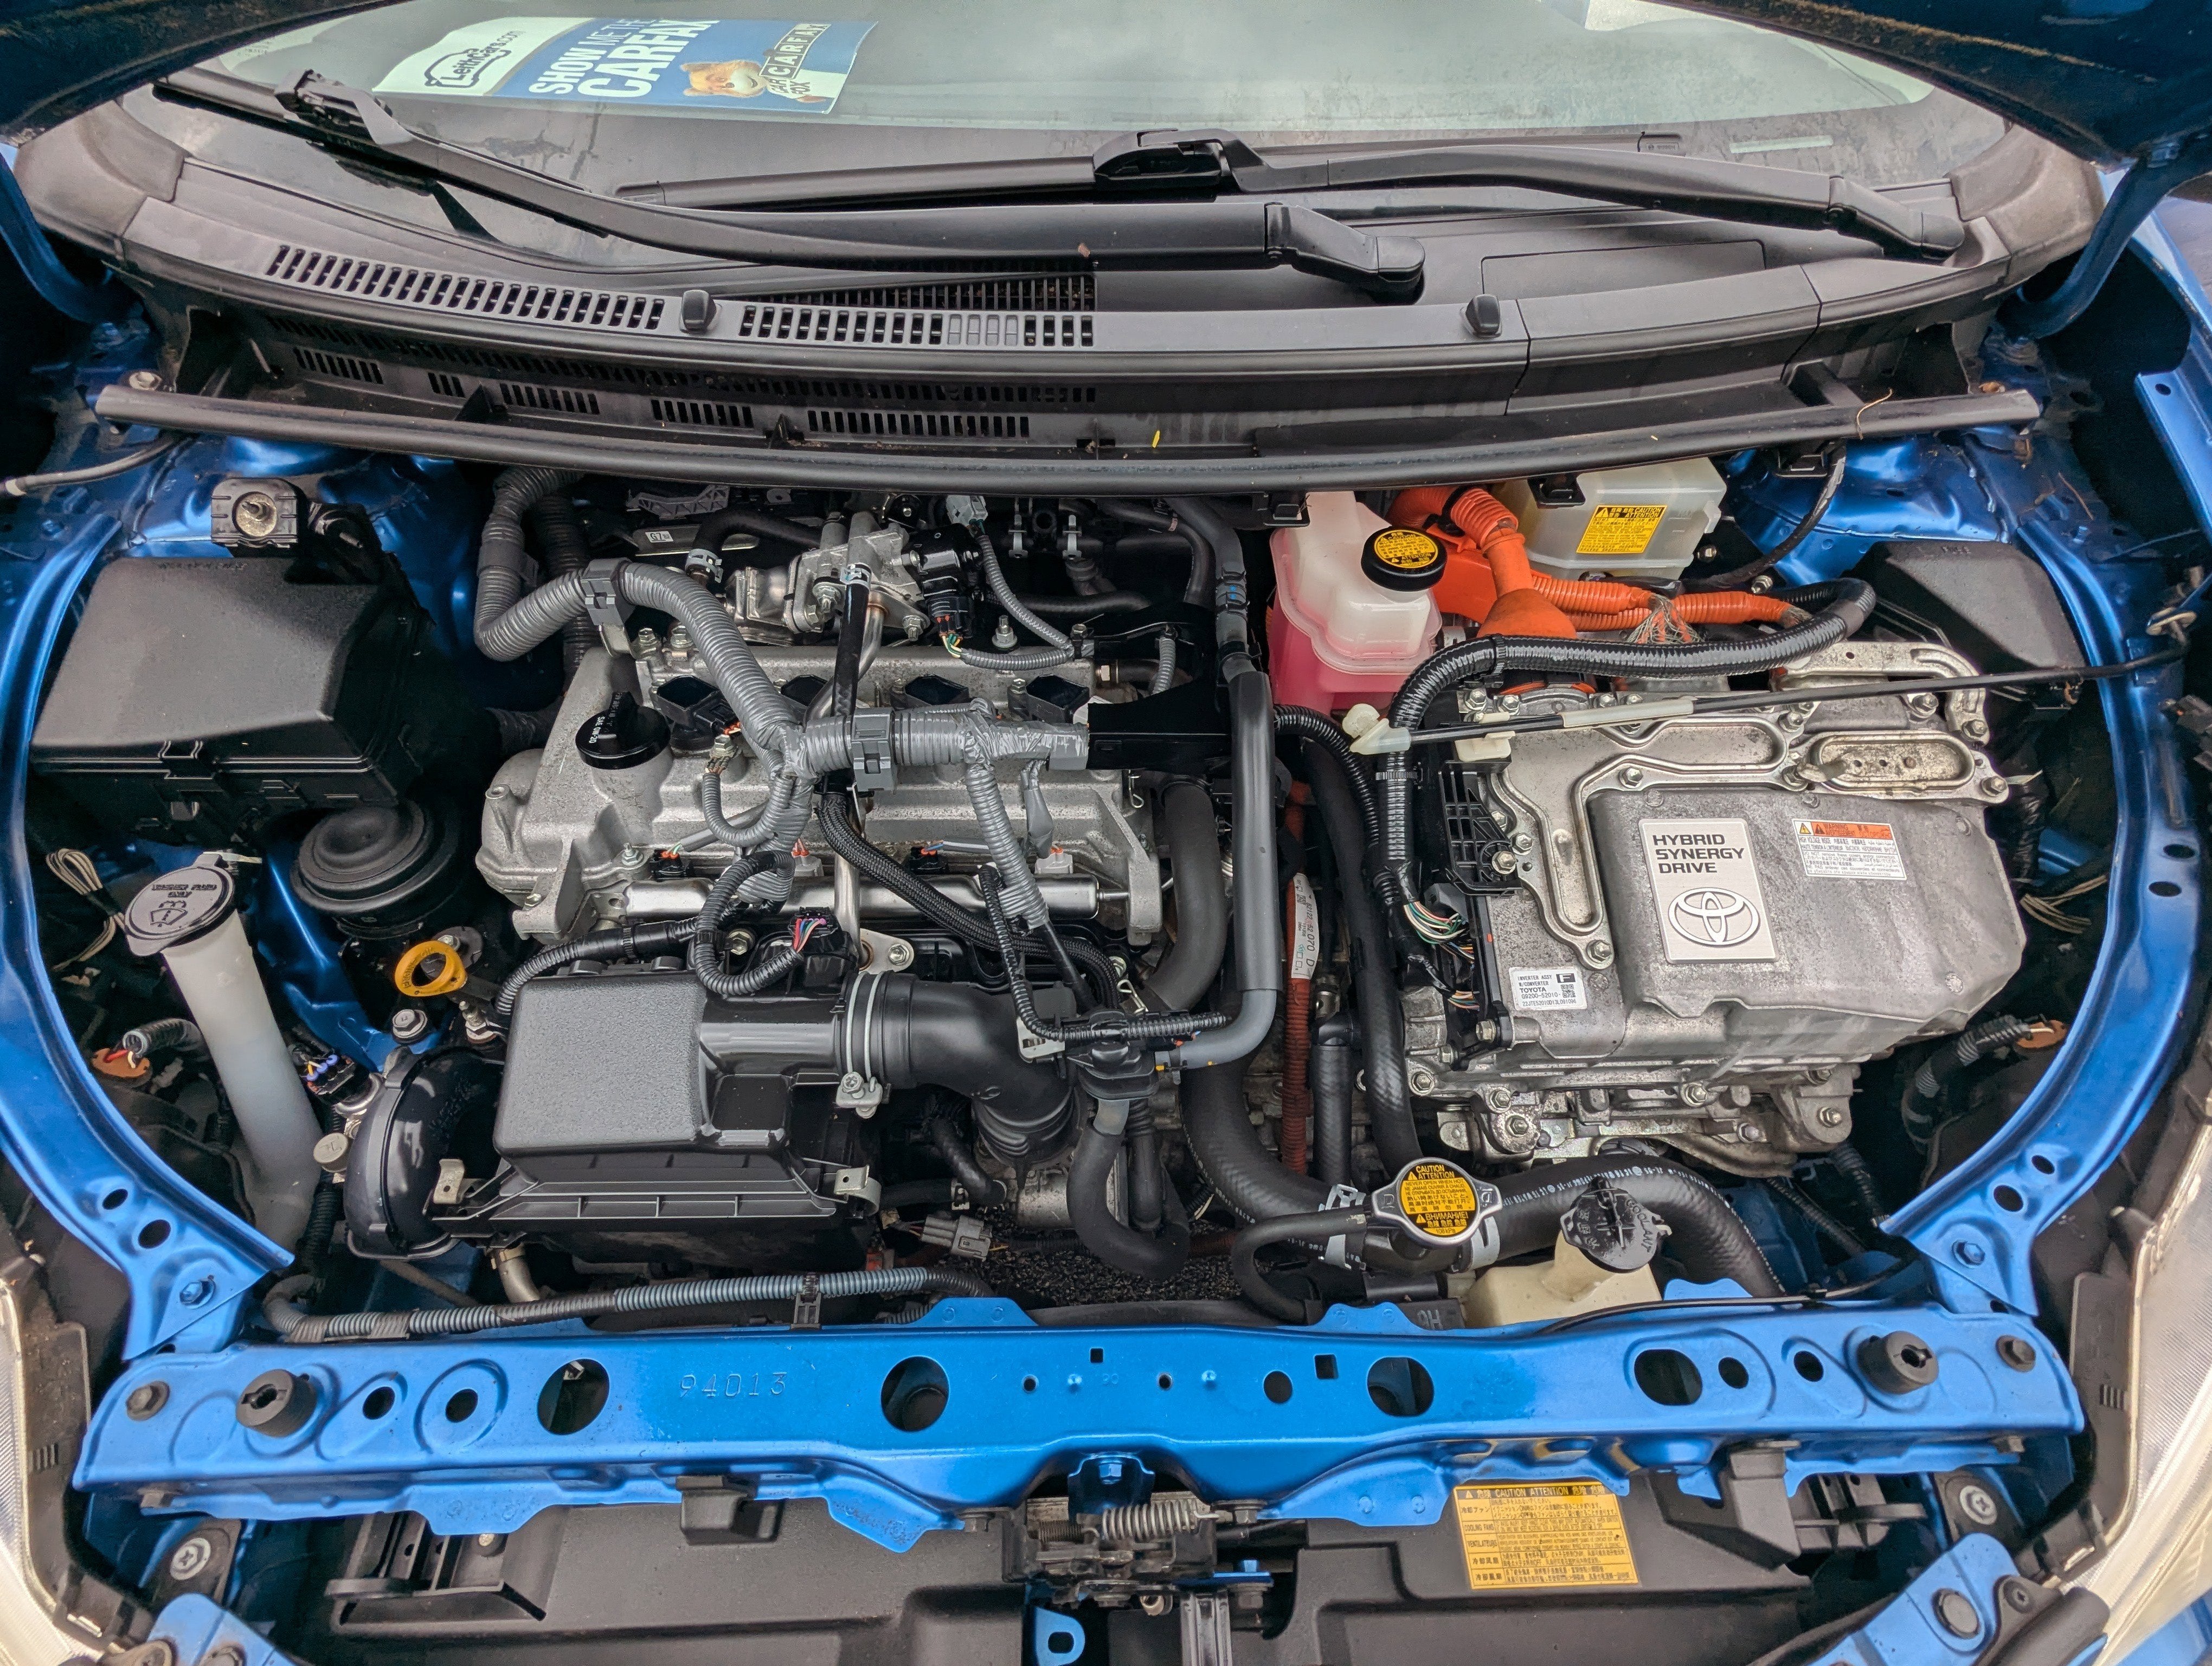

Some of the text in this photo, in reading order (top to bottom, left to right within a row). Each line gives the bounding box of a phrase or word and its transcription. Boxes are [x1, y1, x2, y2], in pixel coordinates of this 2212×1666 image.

[768, 24, 828, 75] CARFAX
[529, 48, 607, 94] SHOW
[578, 31, 633, 46] ME
[577, 19, 721, 98] CARFAX
[1652, 834, 1726, 846] HYBRID
[1655, 848, 1744, 860] SYNERGY
[1658, 862, 1718, 874] DRIVE
[1307, 933, 1315, 952] 070
[1306, 958, 1315, 967] D
[1560, 974, 1572, 983] F
[1416, 1164, 1445, 1173] CAUTION
[1418, 1171, 1455, 1180] ATTENTION
[1425, 1212, 1469, 1220] ВНИМАНИЕ!
[1626, 1199, 1654, 1253] COOLANT
[680, 1372, 787, 1398] 94013
[1495, 1488, 1526, 1497] CAUTION
[1530, 1486, 1569, 1496] ATTENTION
